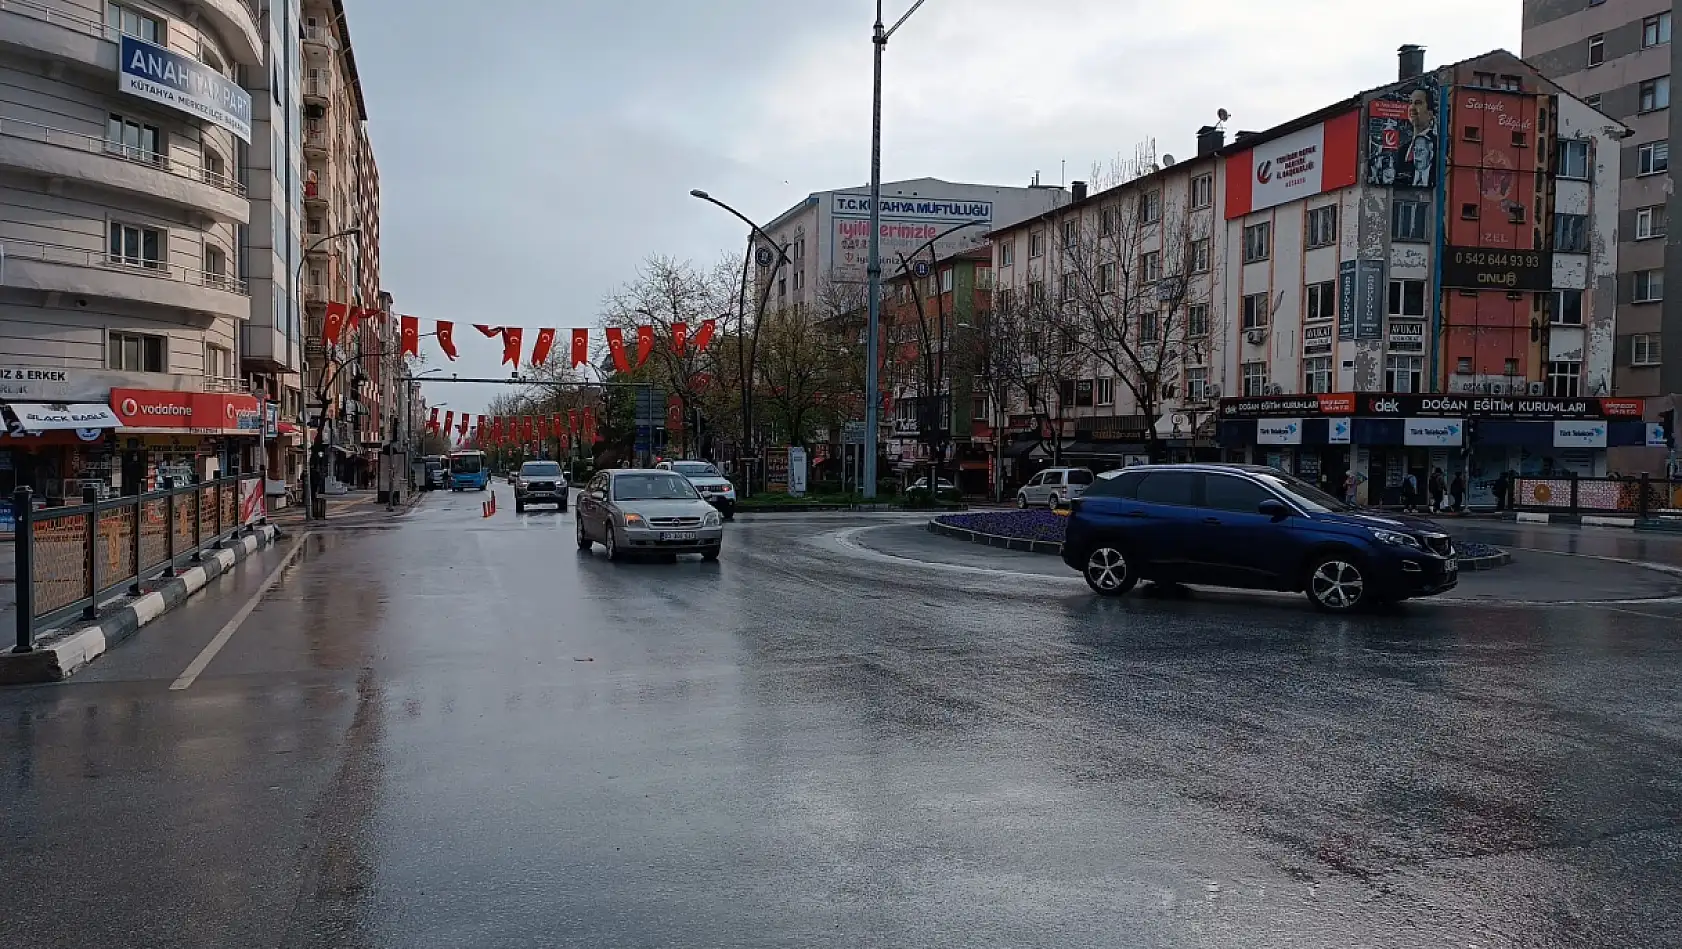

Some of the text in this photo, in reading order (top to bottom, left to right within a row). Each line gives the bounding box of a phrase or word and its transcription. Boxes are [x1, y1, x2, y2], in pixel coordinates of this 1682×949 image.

[131, 79, 174, 100] KÜTAHYA
[837, 198, 989, 217] T.C.KTAHYA MÜFTÜLÜĞÜ
[838, 219, 937, 239] iyilierinizle
[1456, 252, 1539, 268] 0 542 644 93 93
[1391, 324, 1422, 335] AVUKAT
[15, 370, 25, 380] &
[27, 370, 66, 382] ERKEK
[140, 403, 192, 416] vodafone
[1238, 401, 1260, 411] DOĞAN
[1261, 400, 1281, 411] EĞİTİM
[1282, 400, 1319, 410] KURUMLARI
[1374, 397, 1400, 413] dek
[1422, 397, 1586, 413] DOĞAN EĞİTİM KURUMLARI
